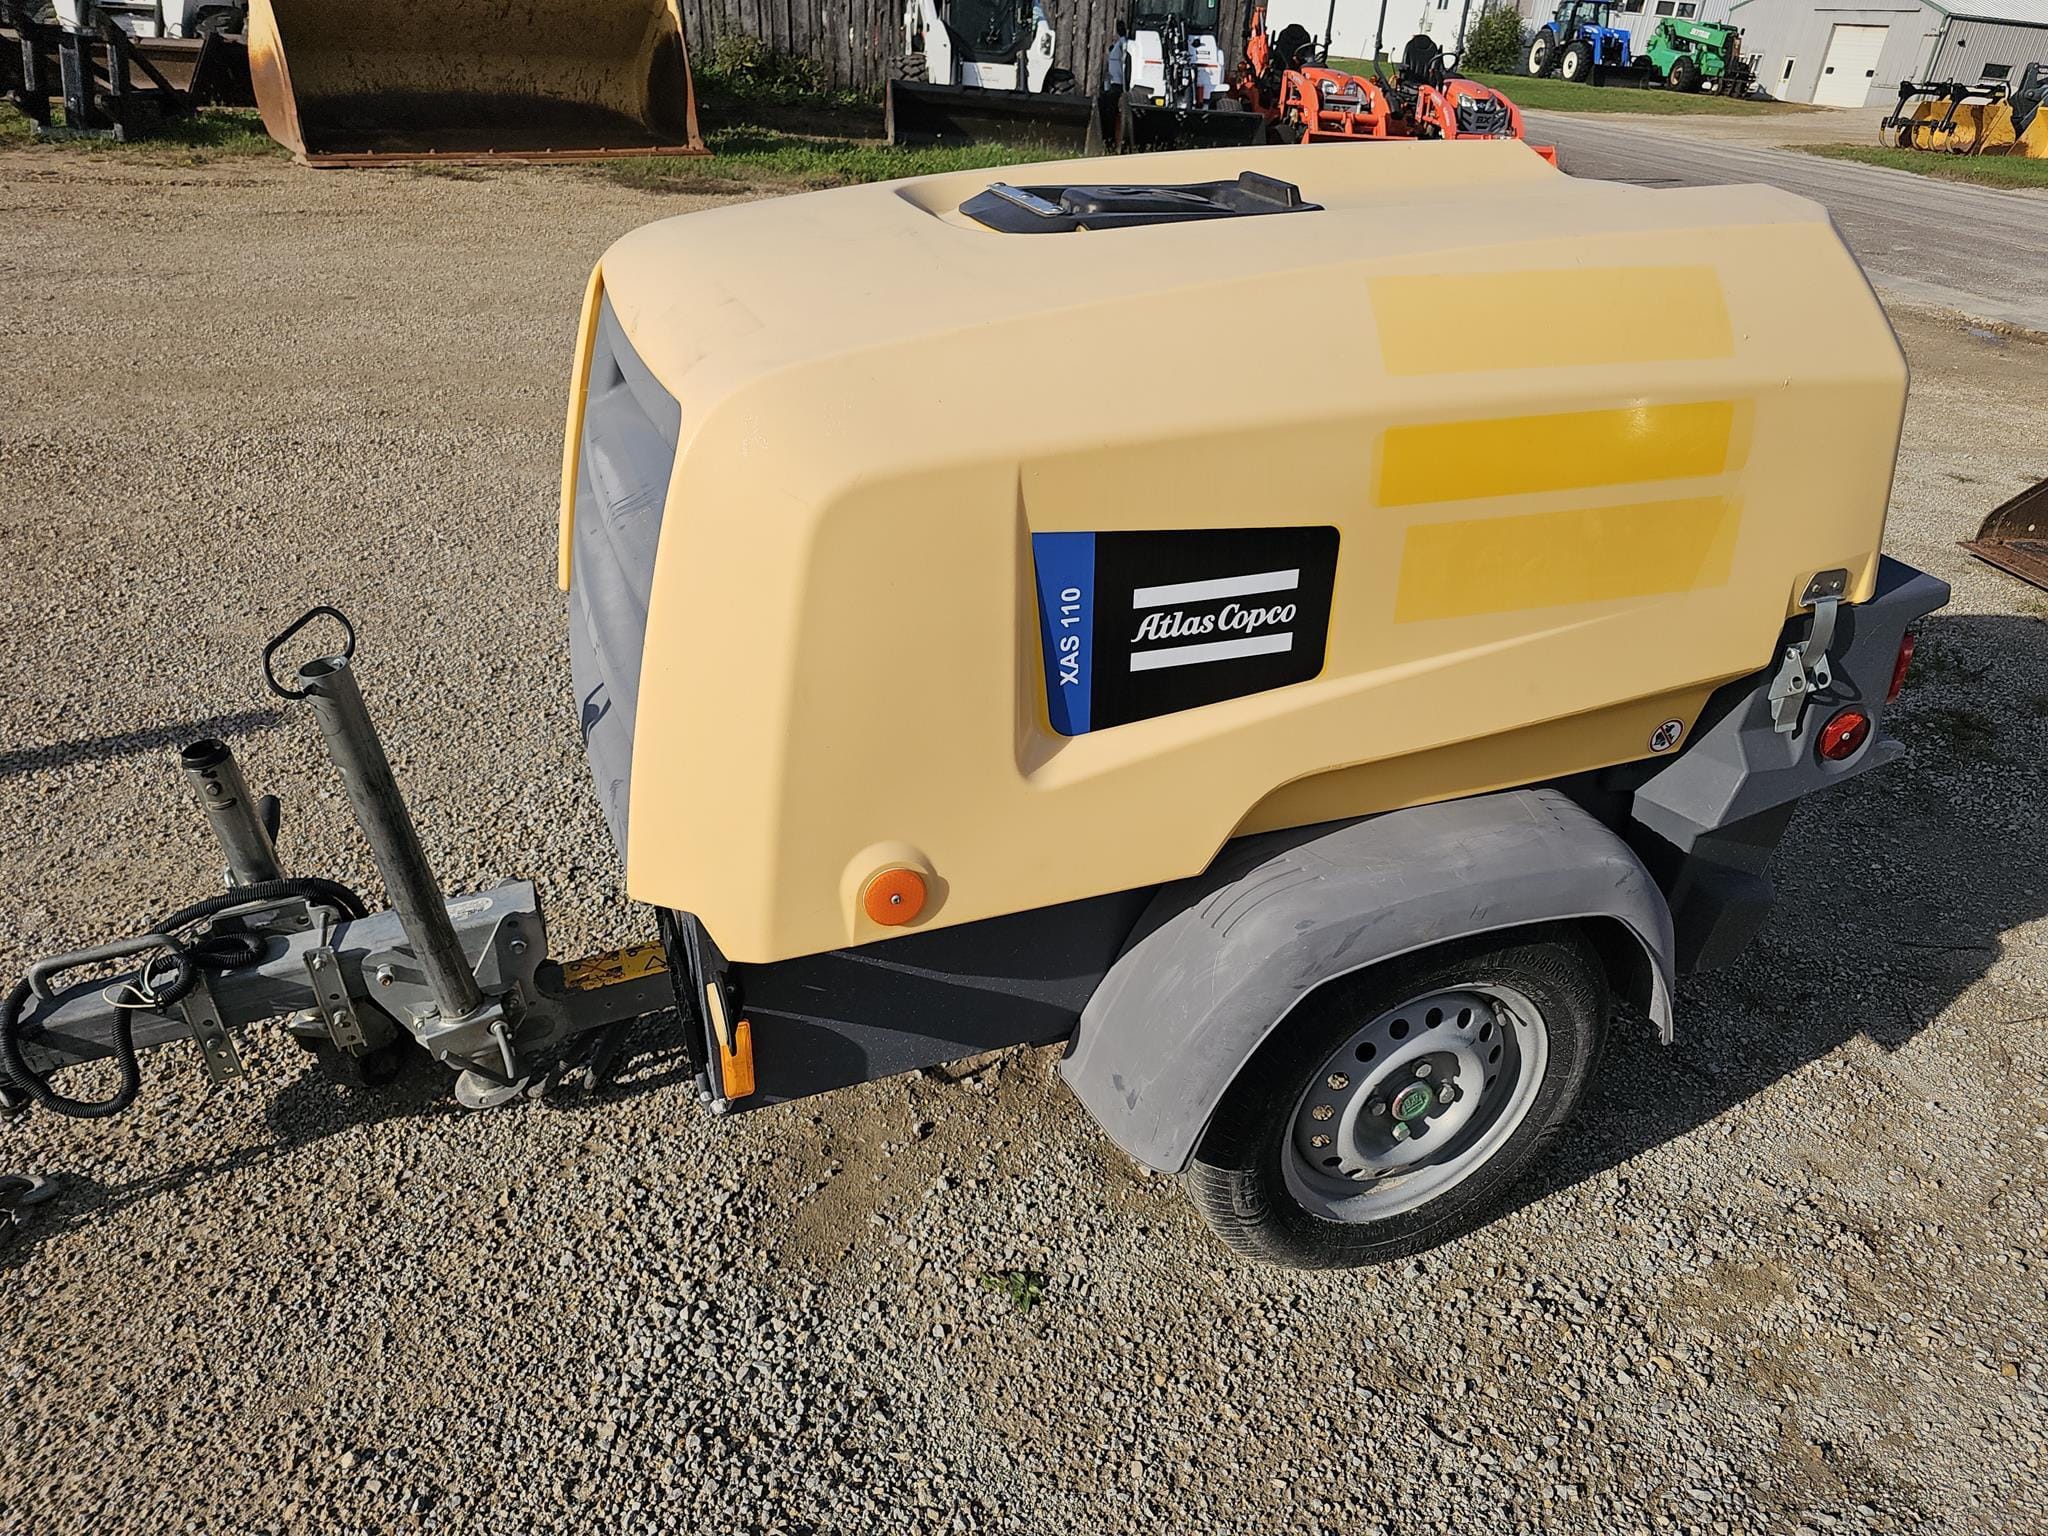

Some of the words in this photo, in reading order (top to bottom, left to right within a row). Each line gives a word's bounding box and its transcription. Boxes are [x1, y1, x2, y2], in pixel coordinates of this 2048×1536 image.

[1060, 587, 1081, 627] 110
[1131, 610, 1215, 642] Atlas
[1217, 603, 1297, 632] Copco
[1059, 636, 1079, 686] XAS
